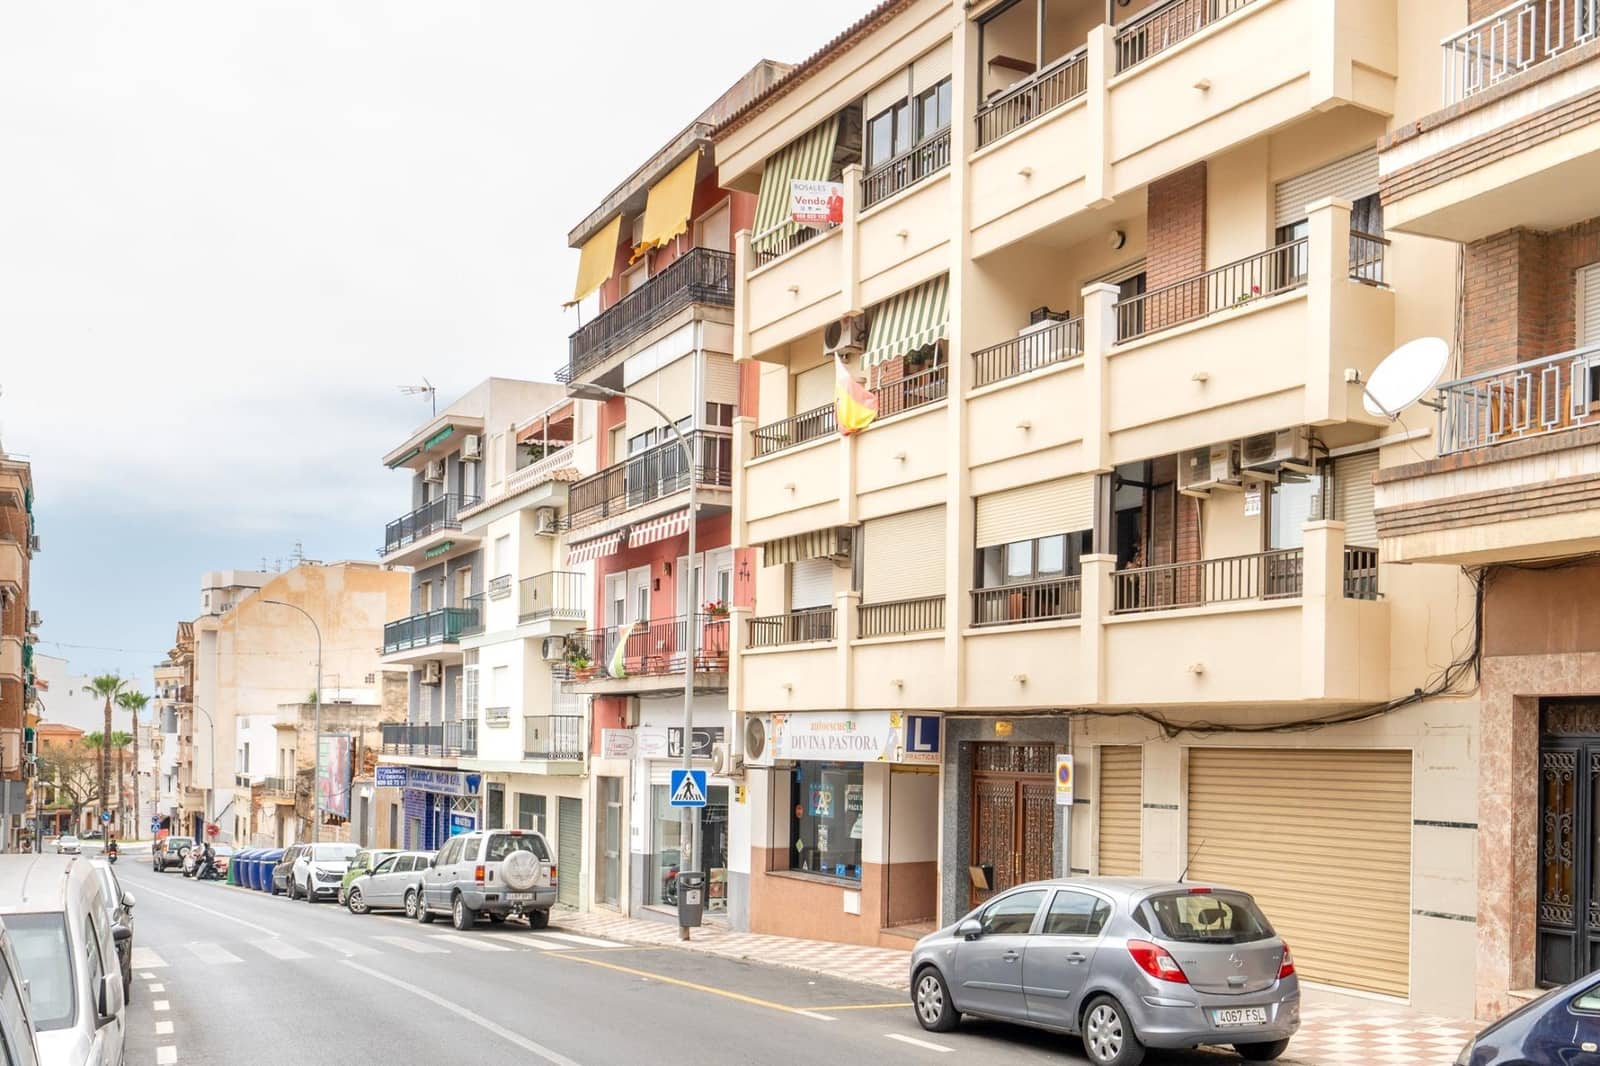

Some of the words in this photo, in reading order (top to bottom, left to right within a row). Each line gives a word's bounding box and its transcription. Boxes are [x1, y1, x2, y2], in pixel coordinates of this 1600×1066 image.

[795, 196, 826, 206] Vendo
[811, 720, 857, 733] autoescuela
[913, 717, 932, 751] L
[791, 735, 826, 751] DIVINA
[828, 735, 878, 751] PASTORA
[1220, 1010, 1242, 1022] 4067
[1245, 1009, 1265, 1021] FSL
